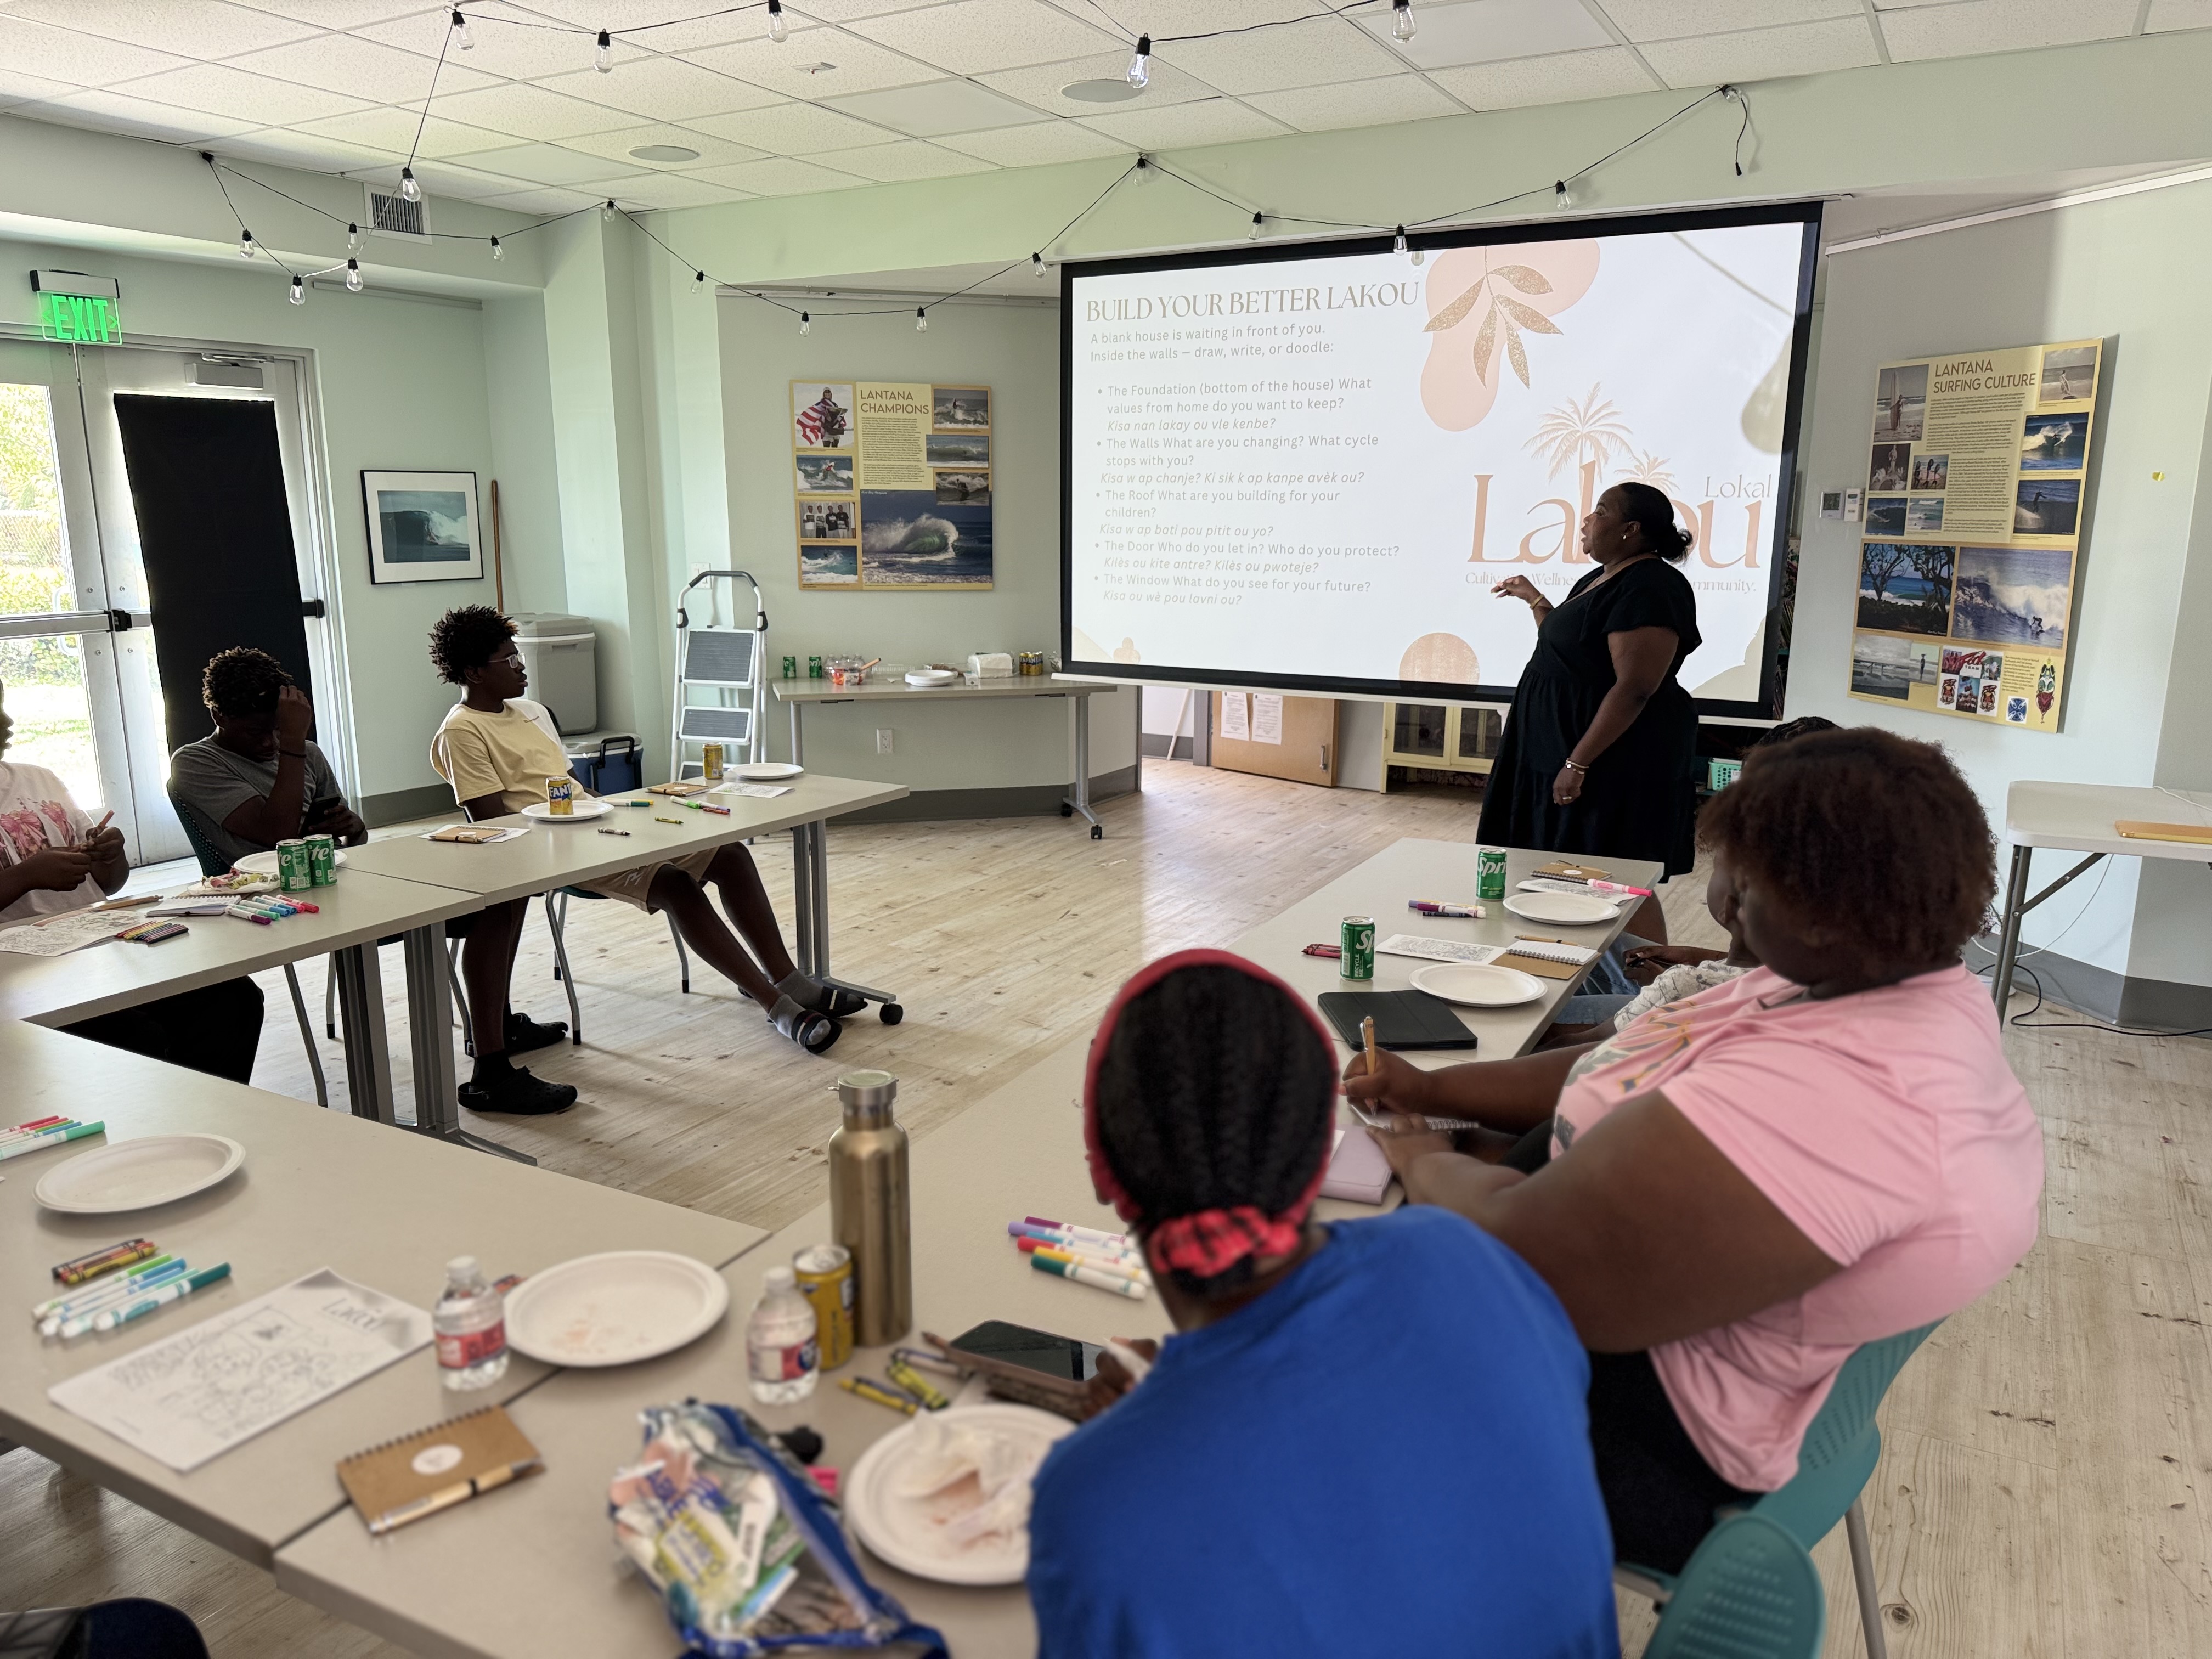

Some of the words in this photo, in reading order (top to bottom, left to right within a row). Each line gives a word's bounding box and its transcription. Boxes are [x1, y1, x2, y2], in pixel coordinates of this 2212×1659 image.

[1087, 297, 1152, 322] BUILD
[1157, 294, 1224, 318] YOUR
[1229, 287, 1321, 314] BETTER
[1326, 282, 1419, 309] LAKOU
[52, 295, 109, 342] EXIT
[1091, 334, 1098, 344] A
[1102, 331, 1132, 343] blank
[1135, 331, 1169, 342] house
[1173, 329, 1181, 341] is
[1186, 327, 1228, 341] waiting
[1232, 326, 1242, 338] in
[1246, 325, 1278, 337] front
[1282, 323, 1295, 335] of
[1298, 325, 1325, 337] you.
[1091, 349, 1124, 362] Inside
[1127, 348, 1146, 360] the
[1149, 347, 1178, 359] walls
[1195, 346, 1226, 359] draw,
[1231, 343, 1265, 358] write,
[1269, 345, 1283, 355] or
[1286, 340, 1334, 354] doodle:
[1934, 359, 1993, 377] LANTANA
[1108, 385, 1127, 397] The
[1131, 383, 1195, 396] Foundation
[1200, 382, 1247, 396] (bottom
[1252, 381, 1265, 392] of
[1268, 380, 1288, 392] the
[1293, 378, 1334, 393] house)
[1339, 377, 1372, 390] What
[1933, 376, 1981, 393] SURFING
[1985, 373, 2036, 389] CULTURE
[860, 390, 913, 401] LANTANA
[861, 402, 929, 415] CHAMPIONS
[1107, 403, 1142, 414] values
[1146, 399, 1172, 413] from
[1177, 401, 1209, 413] home
[1212, 399, 1227, 411] do
[1230, 403, 1252, 414] you
[1257, 399, 1286, 411] want
[1290, 399, 1303, 409] to
[1308, 396, 1344, 413] keep?
[1108, 420, 1131, 431] Kisa
[1134, 422, 1155, 431] nan
[1159, 419, 1191, 433] lakay
[1194, 421, 1208, 430] ou
[1212, 418, 1229, 430] vle
[1233, 417, 1276, 430] kenbe?
[1106, 438, 1126, 449] The
[1130, 437, 1159, 449] Walls
[1163, 437, 1192, 448] What
[1195, 439, 1214, 448] are
[1217, 439, 1239, 450] you
[1243, 435, 1304, 449] changing?
[1308, 435, 1341, 446] What
[1345, 433, 1378, 448] cycle
[1106, 456, 1136, 469] stops
[1139, 455, 1164, 466] with
[1166, 455, 1194, 469] you?
[1101, 472, 1124, 483] Kisa
[1127, 475, 1136, 483] w
[1138, 475, 1153, 486] ap
[1156, 472, 1201, 486] chanje?
[1204, 472, 1216, 483] Ki
[1218, 472, 1235, 483] sik
[1238, 472, 1244, 483] k
[1248, 475, 1262, 486] ap
[1266, 472, 1304, 486] kanpe
[1341, 472, 1364, 483] ou?
[1705, 474, 1771, 498] Lokal
[1105, 489, 1125, 500] The
[1128, 489, 1155, 500] Roof
[1158, 489, 1187, 500] What
[1211, 492, 1233, 504] you
[1238, 489, 1285, 504] building
[1289, 489, 1308, 501] for
[1311, 492, 1340, 504] your
[1105, 506, 1156, 518] children?
[1467, 460, 1762, 568] Lau
[1099, 523, 1122, 534] Kisa
[1126, 527, 1135, 535] w
[1137, 527, 1151, 537] ap
[1154, 524, 1178, 535] bati
[1181, 527, 1203, 538] pou
[1205, 524, 1231, 538] pitit
[1234, 528, 1249, 537] ou
[1251, 526, 1273, 540] yo?
[1104, 540, 1124, 551] The
[1128, 541, 1154, 551] Door
[1158, 541, 1182, 552] Who
[1186, 541, 1199, 553] do
[1203, 545, 1224, 556] you
[1228, 542, 1244, 554] let
[1248, 543, 1264, 554] in?
[1268, 543, 1295, 555] Who
[1299, 544, 1313, 555] do
[1317, 546, 1340, 558] you
[1345, 546, 1399, 558] protect?
[1150, 558, 1170, 569] kite
[1173, 560, 1211, 571] antre?
[1245, 563, 1260, 572] ou
[1262, 562, 1319, 575] pwoteje?
[1104, 573, 1124, 584] The
[1126, 574, 1169, 585] Window
[1173, 575, 1203, 587] What
[1206, 577, 1220, 588] do
[1223, 579, 1244, 590] you
[1248, 580, 1268, 589] see
[1272, 578, 1290, 590] for
[1293, 582, 1321, 592] your
[1325, 580, 1370, 592] future?
[1103, 590, 1126, 601] Kisa
[1164, 595, 1186, 605] pou
[1189, 592, 1218, 605] lavni
[1221, 595, 1242, 605] ou?
